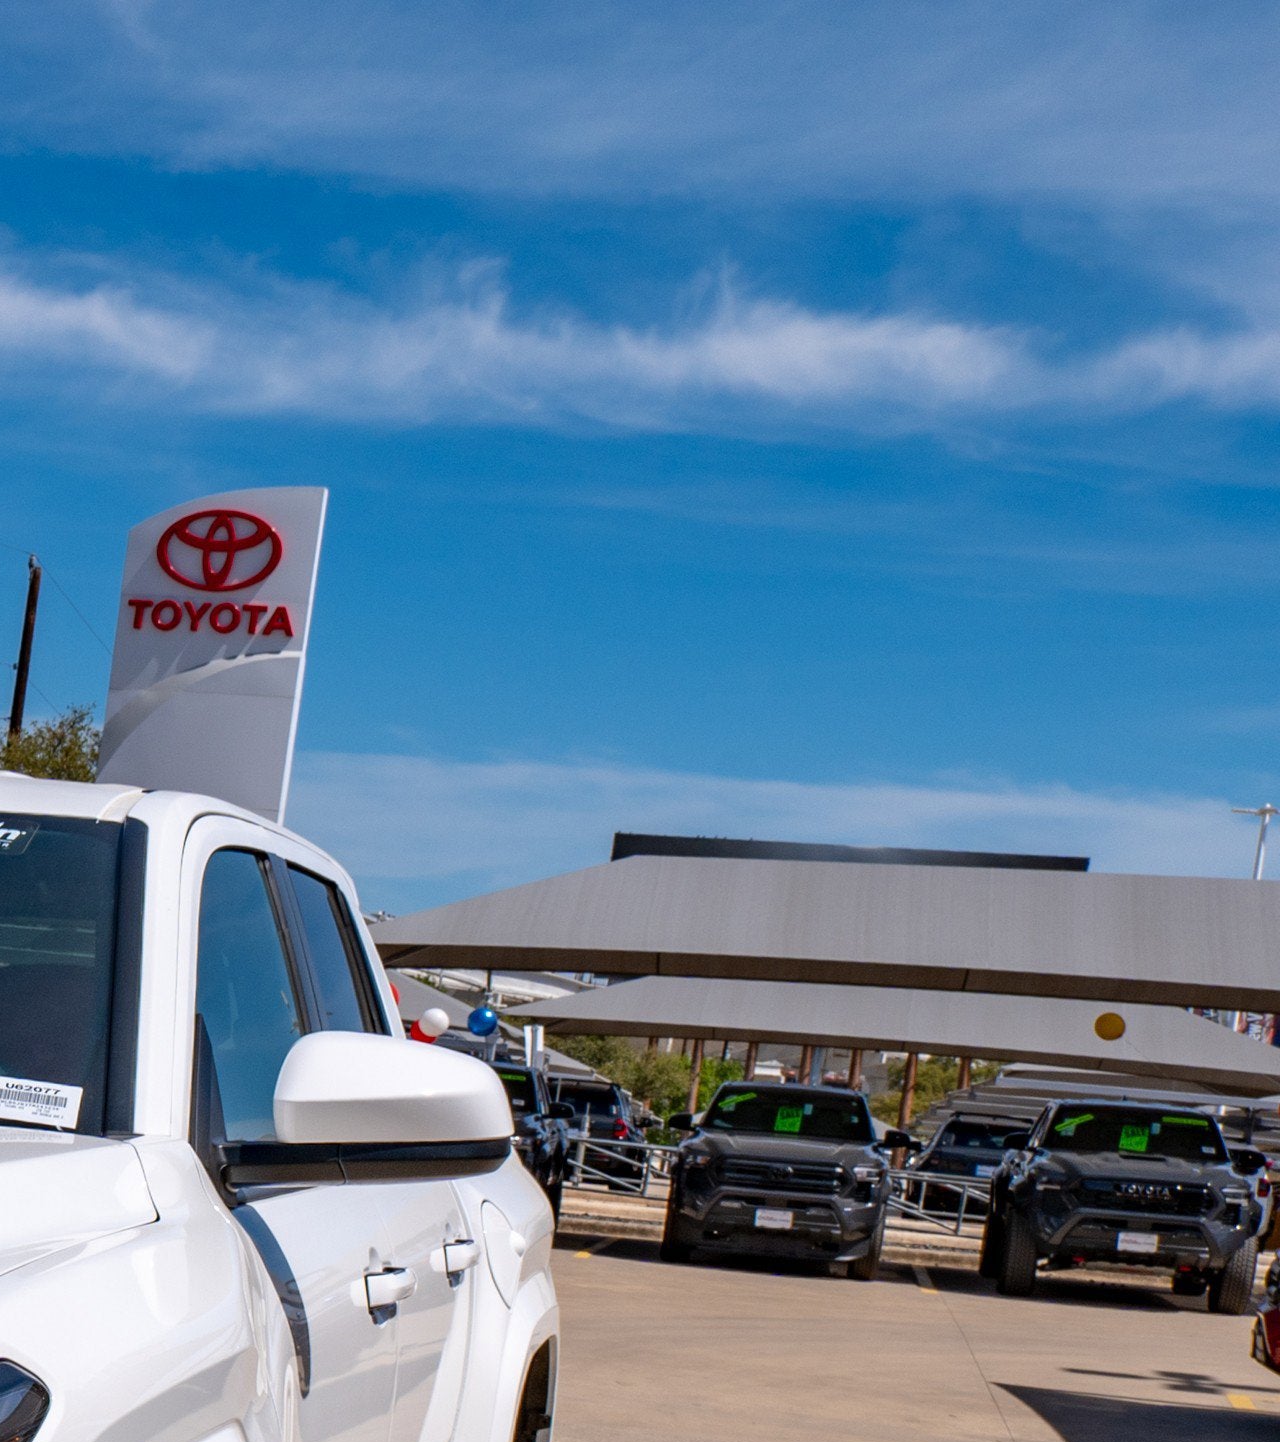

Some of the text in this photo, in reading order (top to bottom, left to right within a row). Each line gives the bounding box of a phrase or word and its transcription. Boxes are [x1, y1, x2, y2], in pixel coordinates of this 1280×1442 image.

[127, 599, 294, 637] TOYOTA
[5, 1082, 61, 1095] U62077
[1120, 1184, 1171, 1197] TOYOTA
